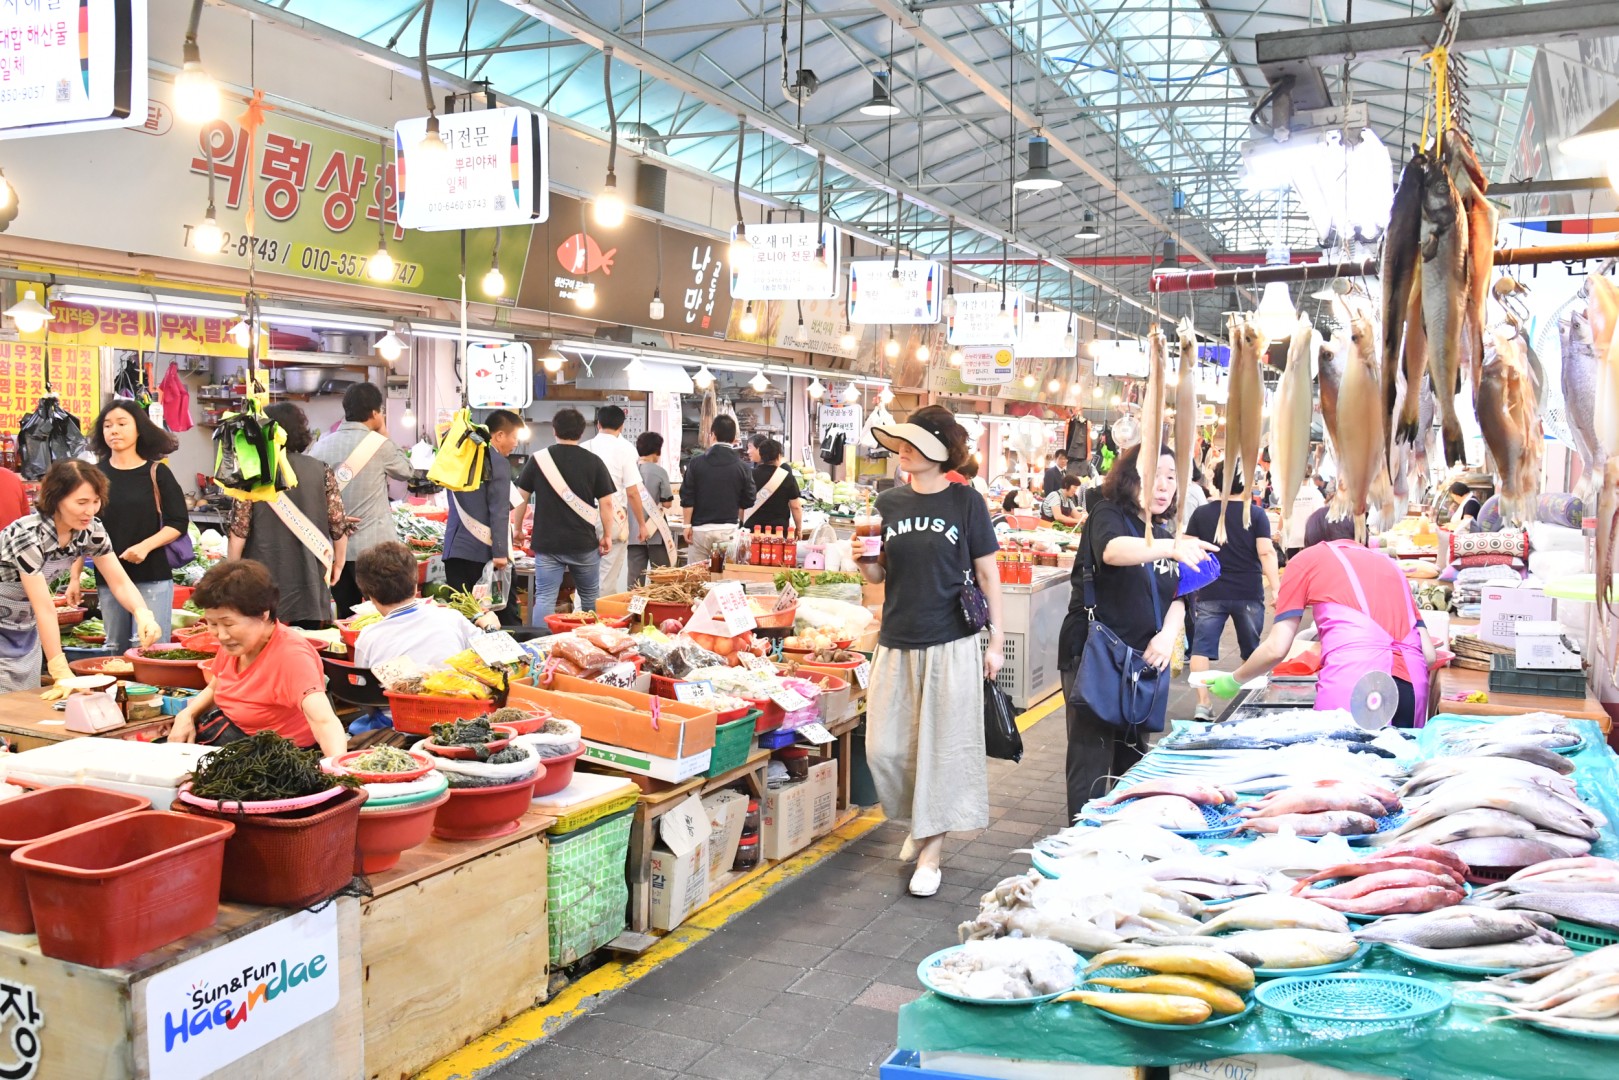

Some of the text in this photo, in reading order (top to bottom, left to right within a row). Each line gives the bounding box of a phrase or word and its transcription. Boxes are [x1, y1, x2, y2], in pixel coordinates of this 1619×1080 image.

[27, 21, 67, 47] 해산물
[455, 154, 497, 172] 뿌리야채
[183, 224, 278, 262] T.2-8743
[301, 247, 417, 284] 010-357-747
[684, 245, 711, 323] 낭만
[705, 261, 722, 316] 고등어
[51, 347, 91, 364] 멸치젓
[51, 365, 91, 381] 조개젓
[885, 516, 959, 545] AMUSE
[164, 954, 328, 1053] Haeundae
[192, 960, 277, 1010] Sun&Fun
